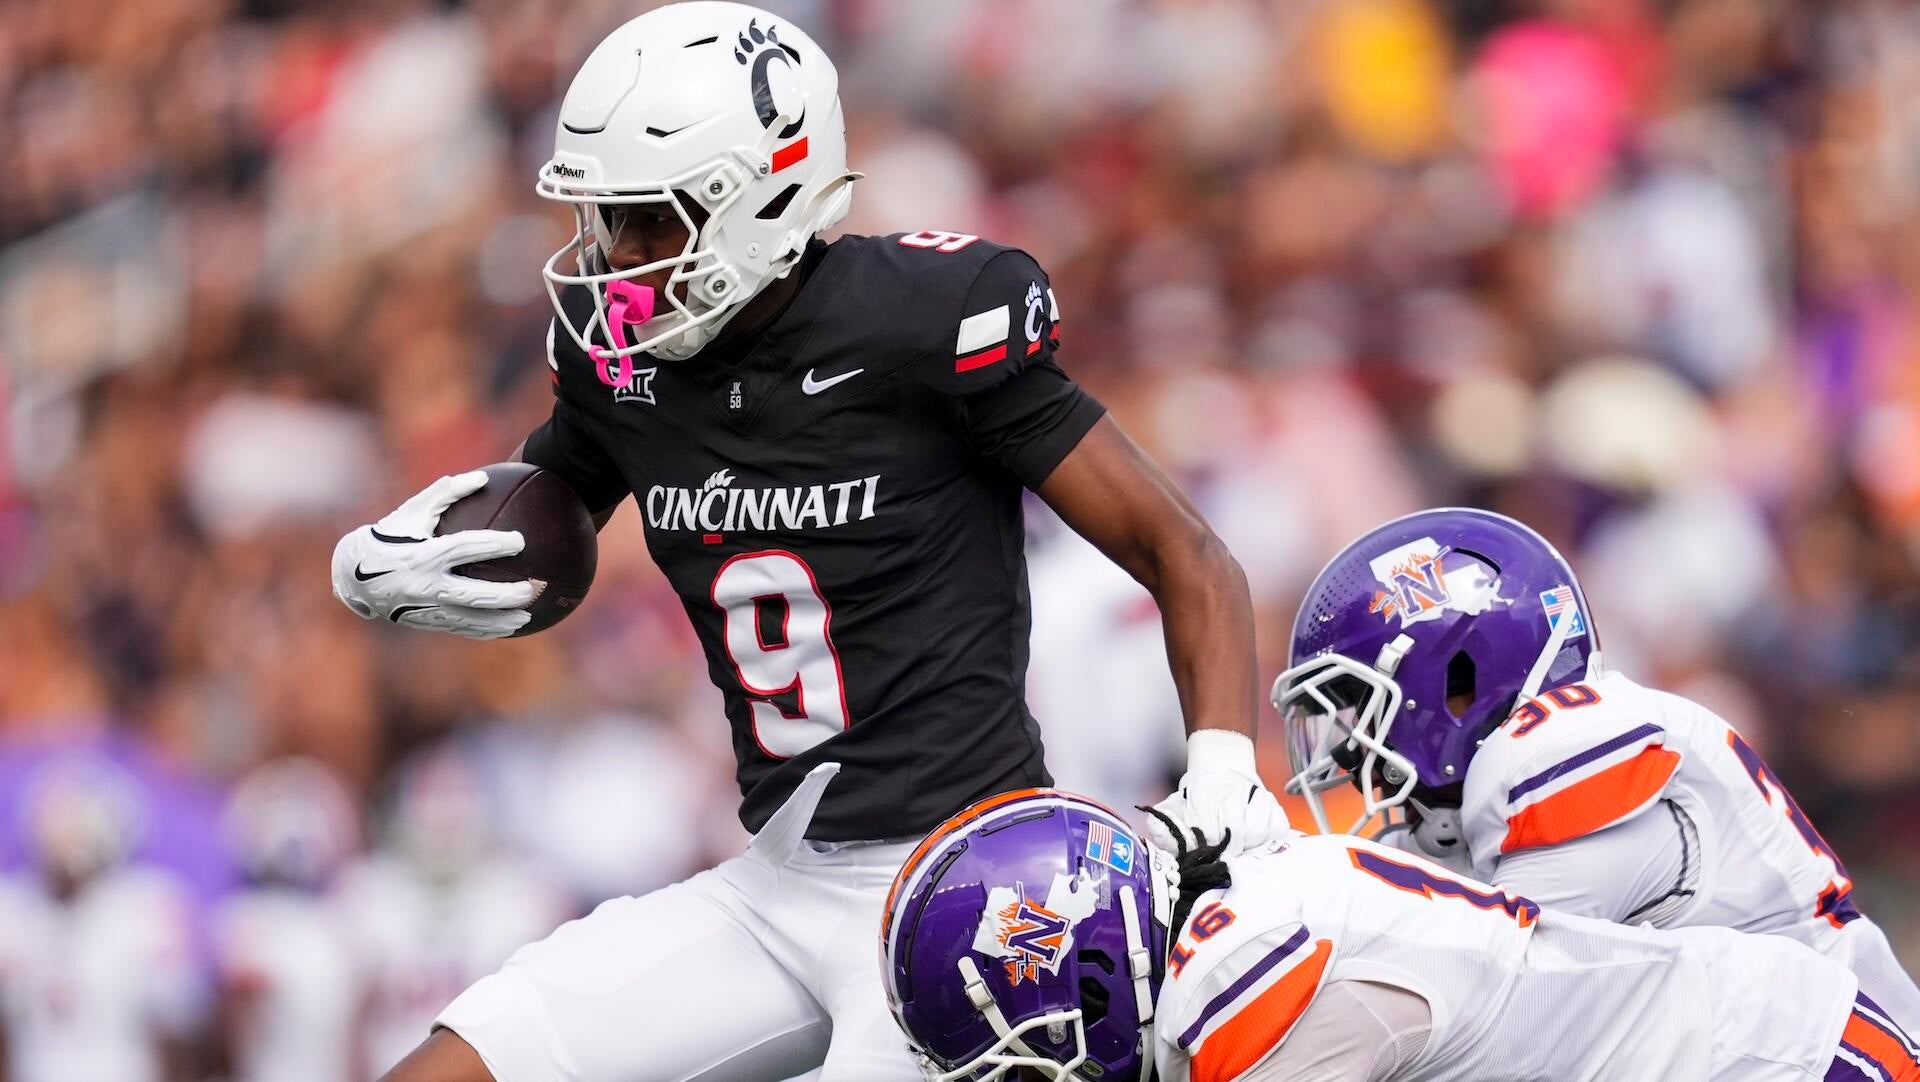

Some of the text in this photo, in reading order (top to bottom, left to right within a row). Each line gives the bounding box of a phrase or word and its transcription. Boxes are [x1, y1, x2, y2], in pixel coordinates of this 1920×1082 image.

[729, 381, 742, 395] JK
[729, 395, 742, 409] 58
[646, 473, 882, 532] CINCINNATI
[1392, 560, 1451, 620] N
[711, 548, 851, 762] 9
[1500, 684, 1602, 739] 30
[1004, 902, 1071, 967] N
[1167, 901, 1238, 981] 16
